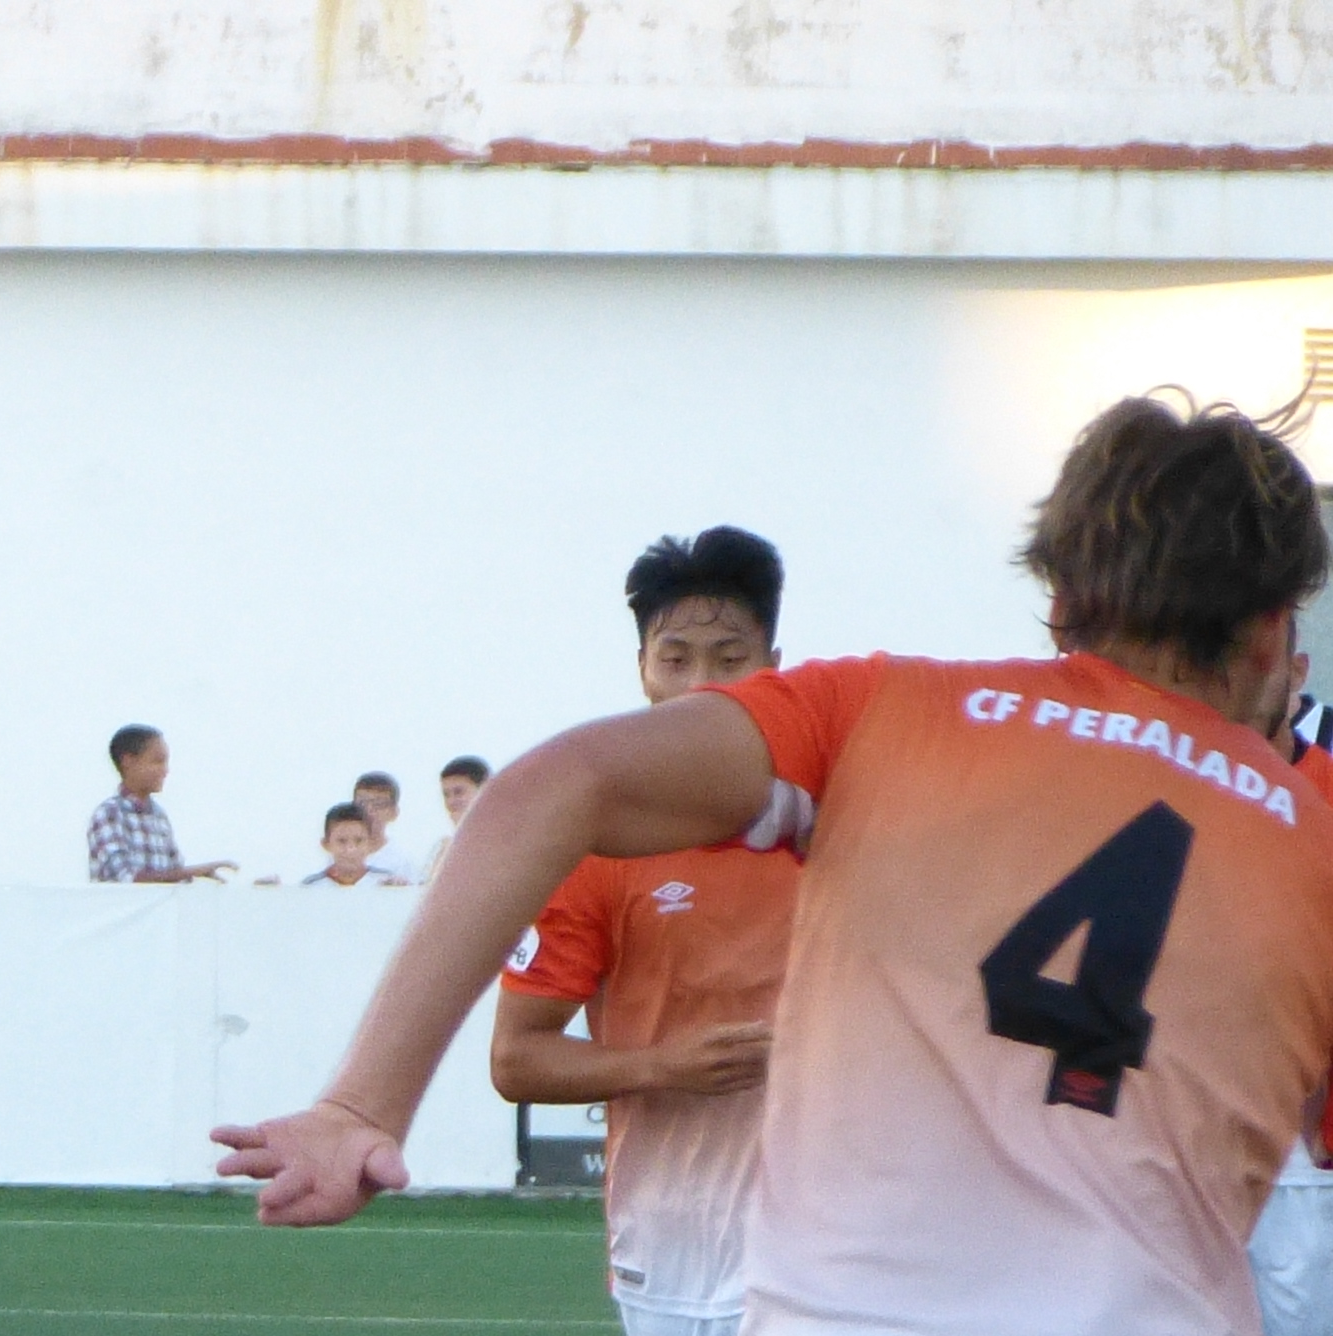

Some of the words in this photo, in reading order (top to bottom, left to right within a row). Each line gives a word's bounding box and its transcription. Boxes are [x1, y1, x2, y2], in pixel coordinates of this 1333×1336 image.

[965, 687, 1024, 722] CF
[1033, 698, 1297, 826] PERALADA
[978, 799, 1196, 1118] 4
